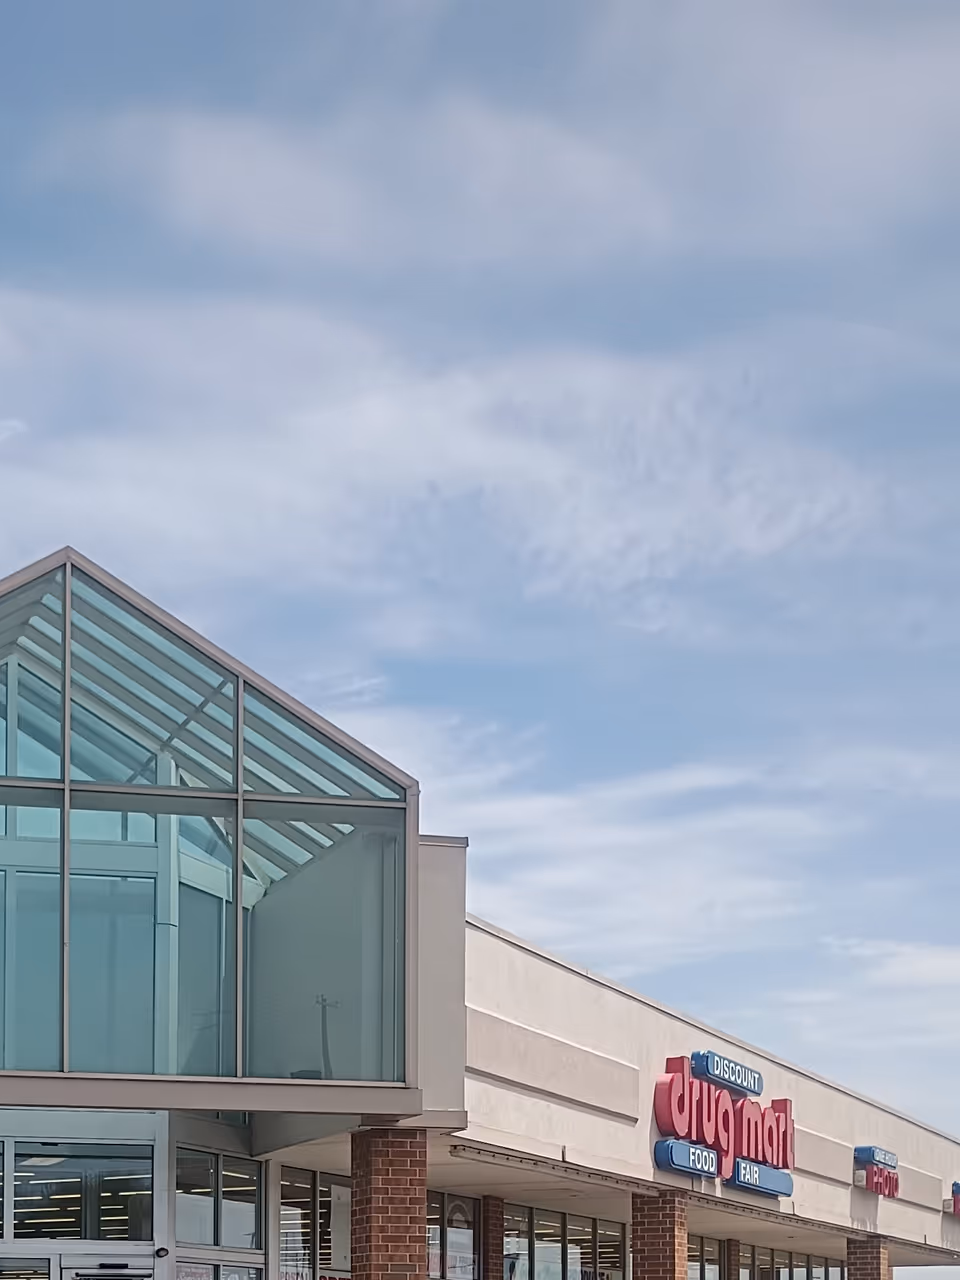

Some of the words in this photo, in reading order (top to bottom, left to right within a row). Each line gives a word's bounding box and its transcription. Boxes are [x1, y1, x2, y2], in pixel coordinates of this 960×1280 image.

[713, 1055, 760, 1091] DISCOUNT
[654, 1056, 734, 1179] drug
[736, 1098, 795, 1171] mart
[689, 1147, 716, 1173] FOOD
[740, 1163, 759, 1185] FAIR
